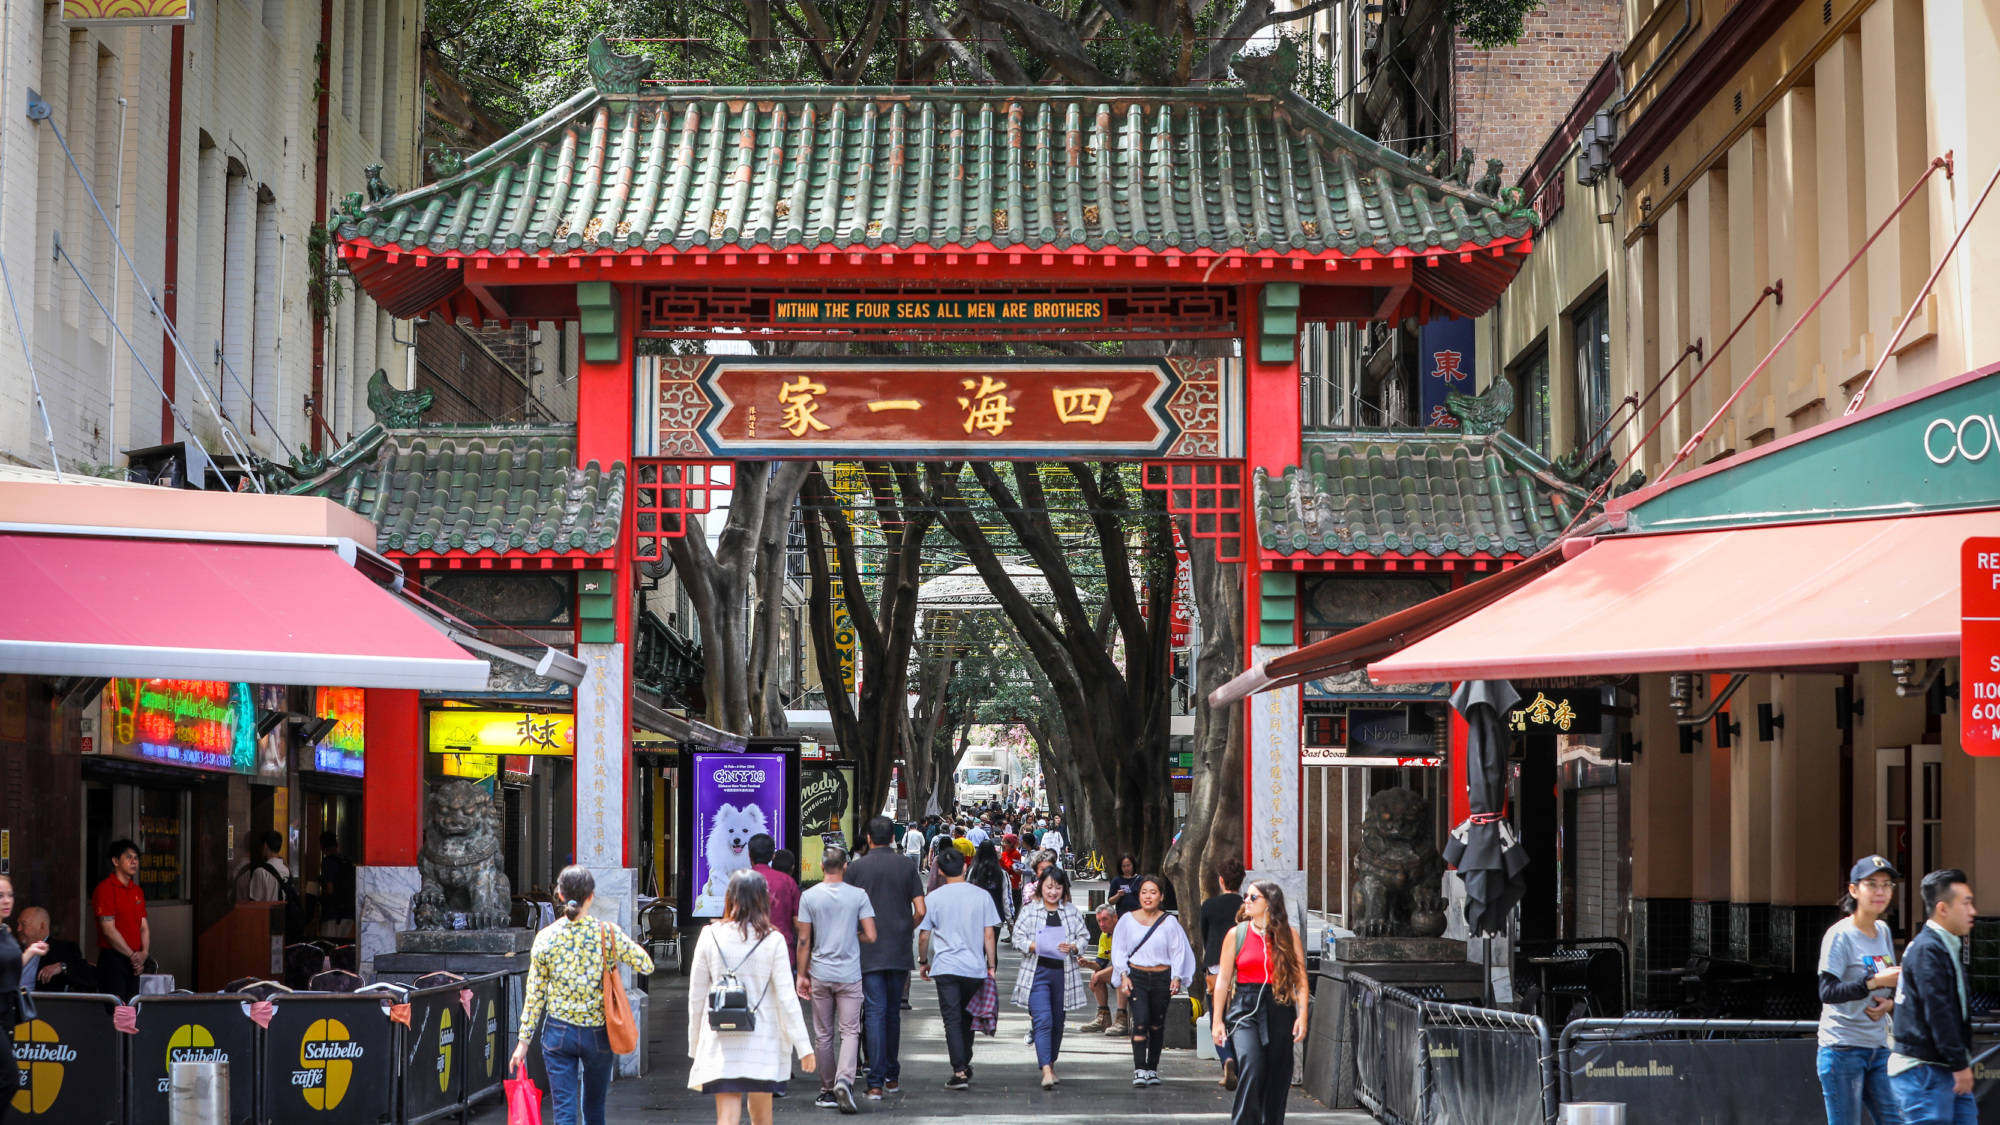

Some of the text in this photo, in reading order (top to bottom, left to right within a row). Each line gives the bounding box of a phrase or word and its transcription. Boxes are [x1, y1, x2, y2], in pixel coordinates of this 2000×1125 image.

[777, 302, 1101, 318] WITHIN THE FOUR SEAS ALL MEN ARE BROTHERS
[304, 1041, 364, 1060] Schibello
[1586, 1059, 1674, 1077] Covent Garden Hotel
[291, 1068, 323, 1088] caffé
